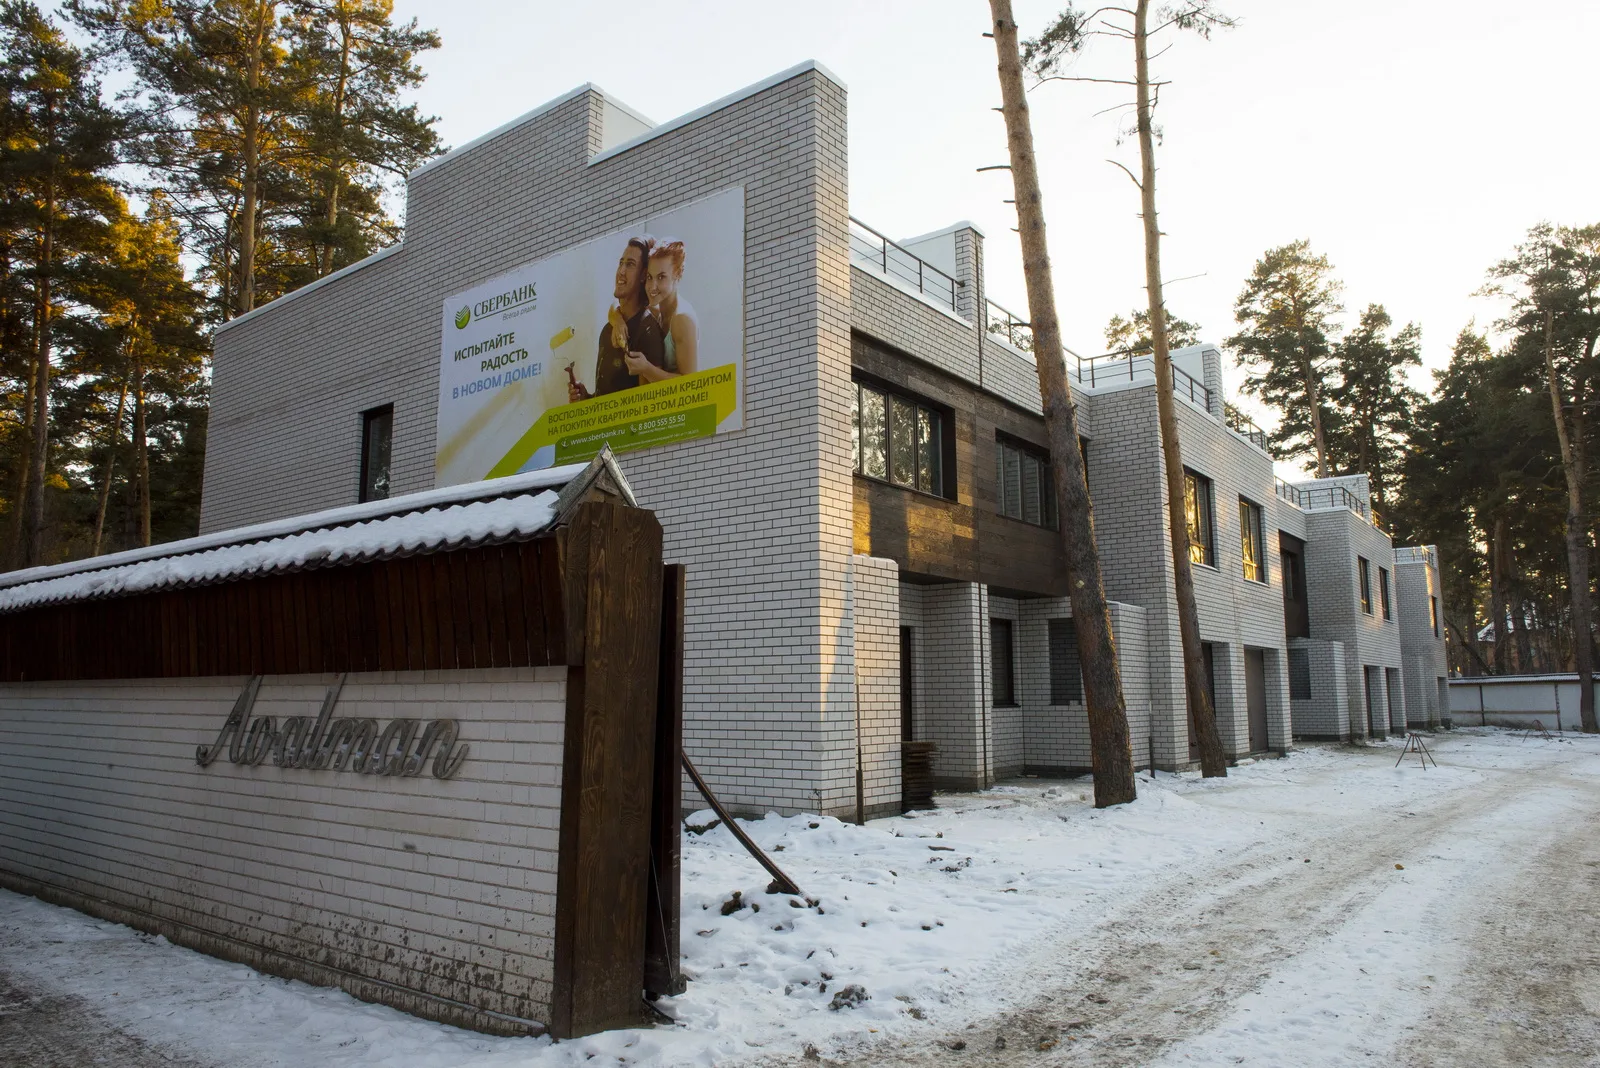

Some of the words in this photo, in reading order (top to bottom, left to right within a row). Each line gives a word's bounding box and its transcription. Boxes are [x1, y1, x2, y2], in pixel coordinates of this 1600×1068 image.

[474, 282, 537, 317] СБЕРБАНК
[454, 332, 515, 361] ИСПЫТАЙТЕ
[481, 348, 528, 372] РАДОСТЬ
[453, 387, 459, 399] В
[461, 374, 502, 396] НОВОМ
[503, 363, 542, 387] ДОМЕ!
[548, 400, 619, 424] ВОСПОЛЬЗУЙТЕСЬ
[620, 385, 678, 406] ЖИЛИЩНЫМ
[680, 372, 732, 392] КРЕДИТОМ
[548, 426, 559, 436] НА
[560, 417, 597, 433] ПОКУПКУ
[598, 406, 642, 425] КВАРТИРЫ
[643, 404, 649, 414] В
[650, 399, 676, 413] ЭТОМ
[677, 391, 709, 408] ДОМЕ!
[570, 428, 626, 446] www.sberbank.ru
[643, 420, 656, 430] 800
[657, 417, 668, 427] 555
[668, 415, 676, 424] 55
[677, 413, 686, 423] 50
